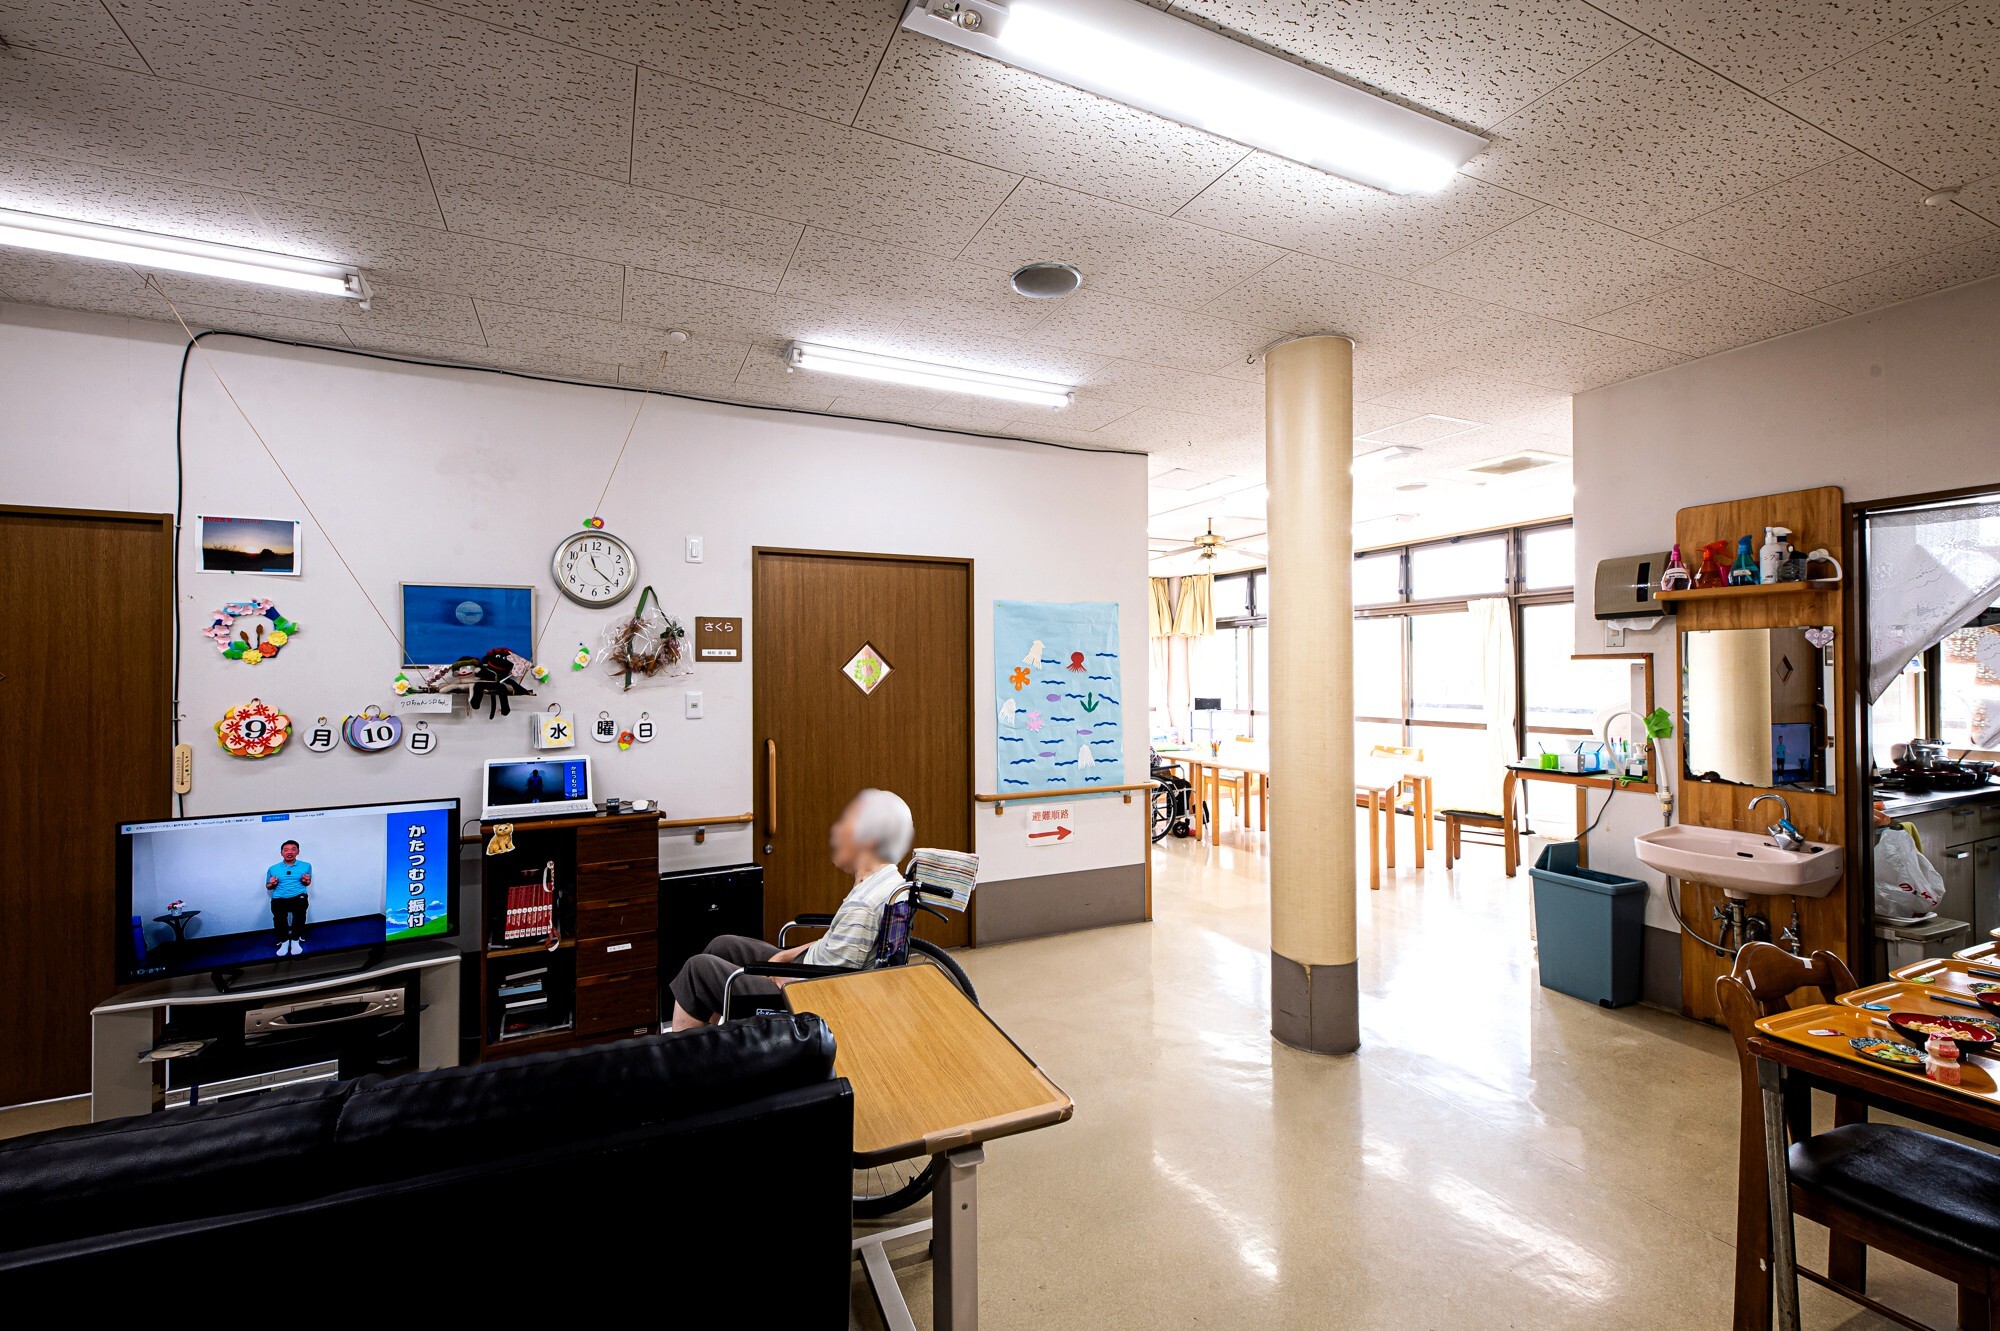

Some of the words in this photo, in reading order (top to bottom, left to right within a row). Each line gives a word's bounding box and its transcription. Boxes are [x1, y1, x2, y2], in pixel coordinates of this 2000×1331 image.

[580, 543, 588, 552] 11
[592, 541, 602, 551] 12
[607, 546, 611, 555] 1
[570, 551, 578, 560] 10
[615, 555, 621, 563] 2
[567, 563, 573, 571] 9
[618, 567, 624, 576] 3
[570, 575, 576, 583] 8
[614, 579, 619, 587] 4
[580, 584, 585, 593] 7
[591, 587, 597, 596] 6
[604, 585, 610, 594] 5
[704, 622, 734, 632] さくら
[244, 719, 267, 739] 9
[309, 729, 331, 746] 月
[363, 725, 393, 744] 10
[411, 733, 429, 749] 日
[550, 723, 568, 740] 水
[597, 720, 614, 736] 曜
[639, 722, 653, 738] 日
[1032, 809, 1069, 821] 避難順路
